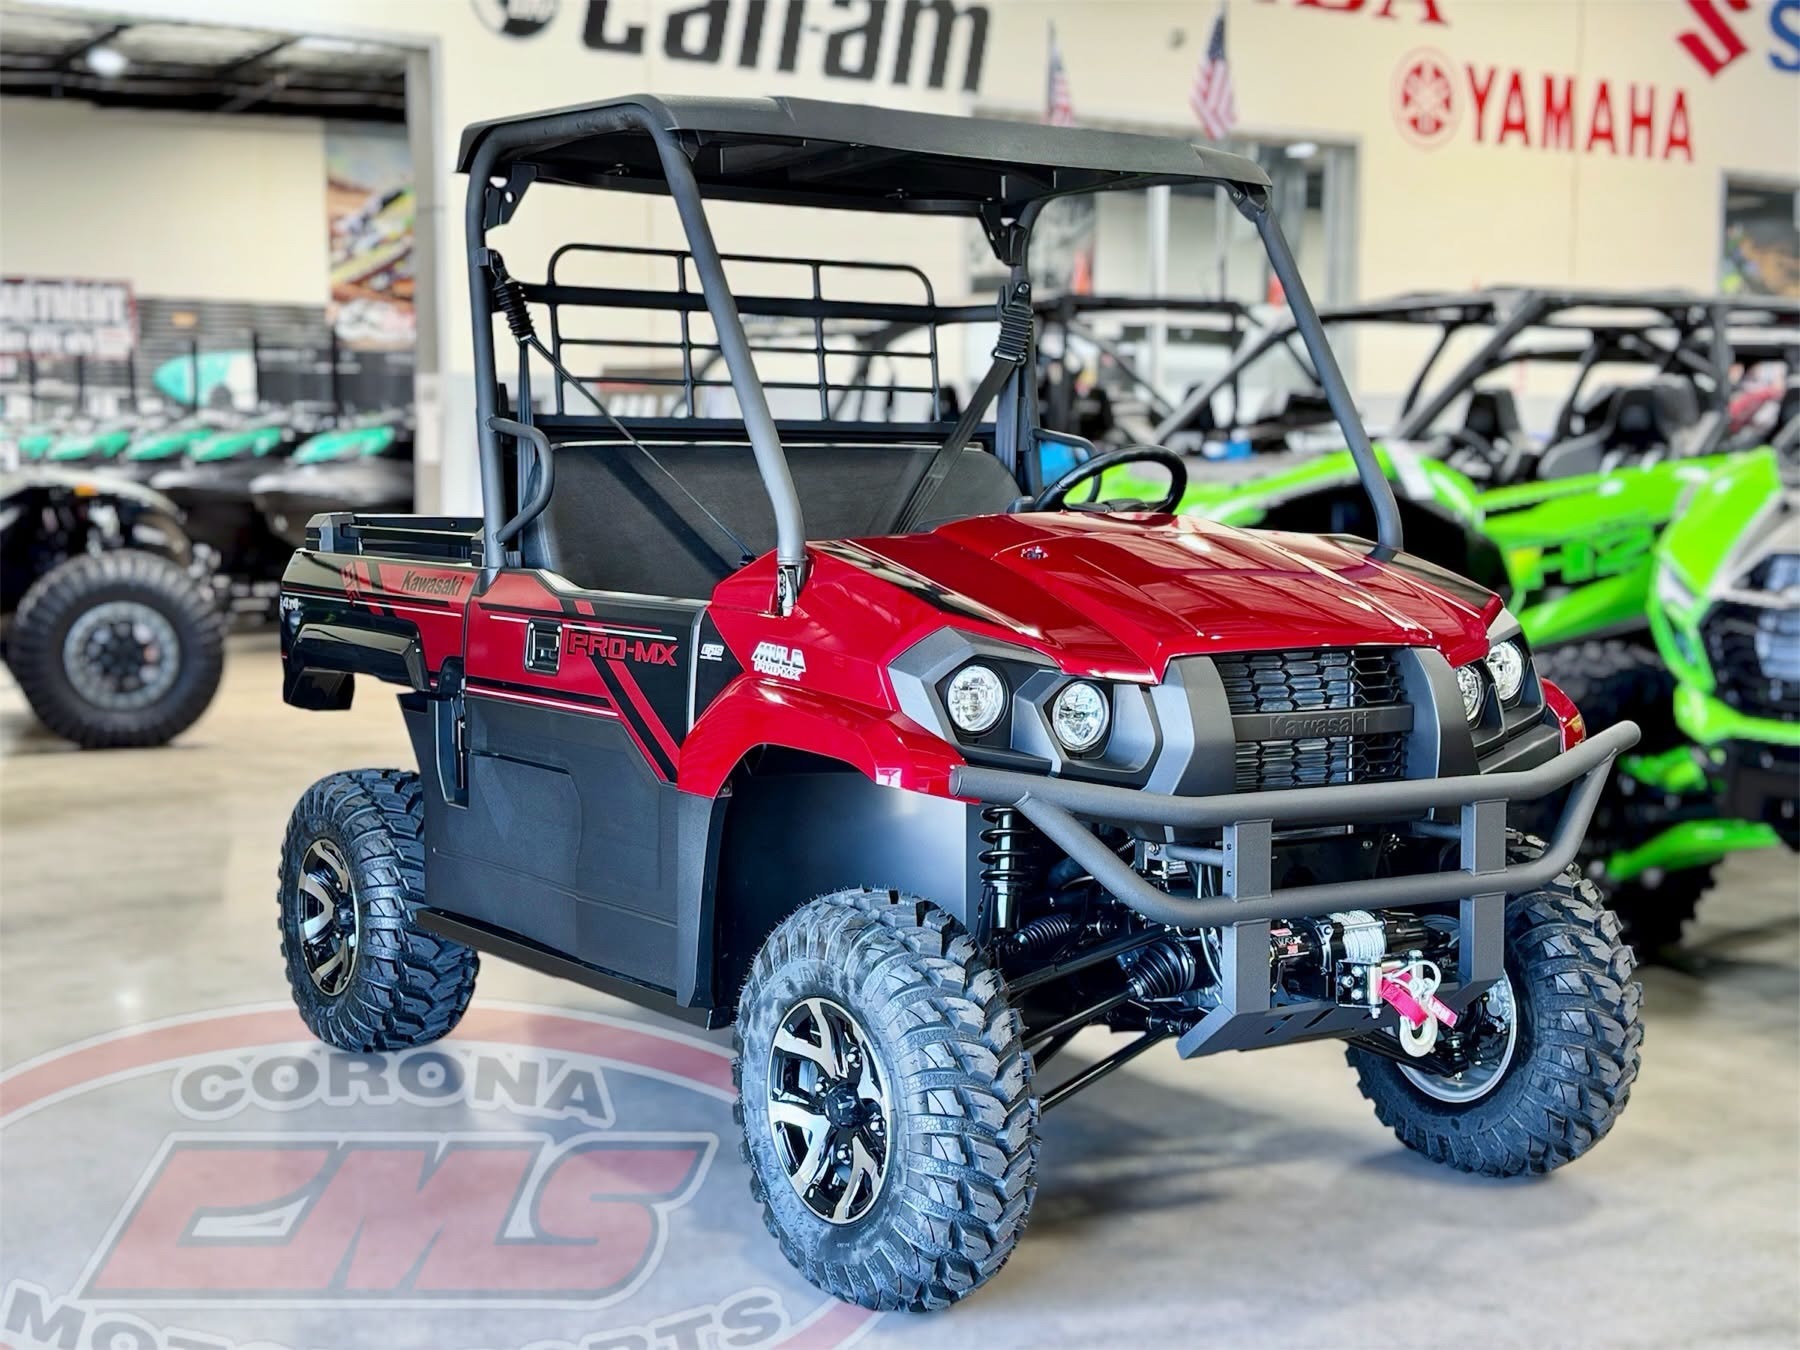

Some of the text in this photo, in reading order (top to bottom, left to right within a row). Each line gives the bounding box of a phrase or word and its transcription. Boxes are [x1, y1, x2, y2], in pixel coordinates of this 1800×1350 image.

[1466, 62, 1695, 164] YAMAHA
[402, 570, 466, 597] Kawasaki
[569, 632, 679, 667] PRO-MX
[1269, 711, 1370, 738] Kawasaki
[180, 1051, 607, 1125] CORONA
